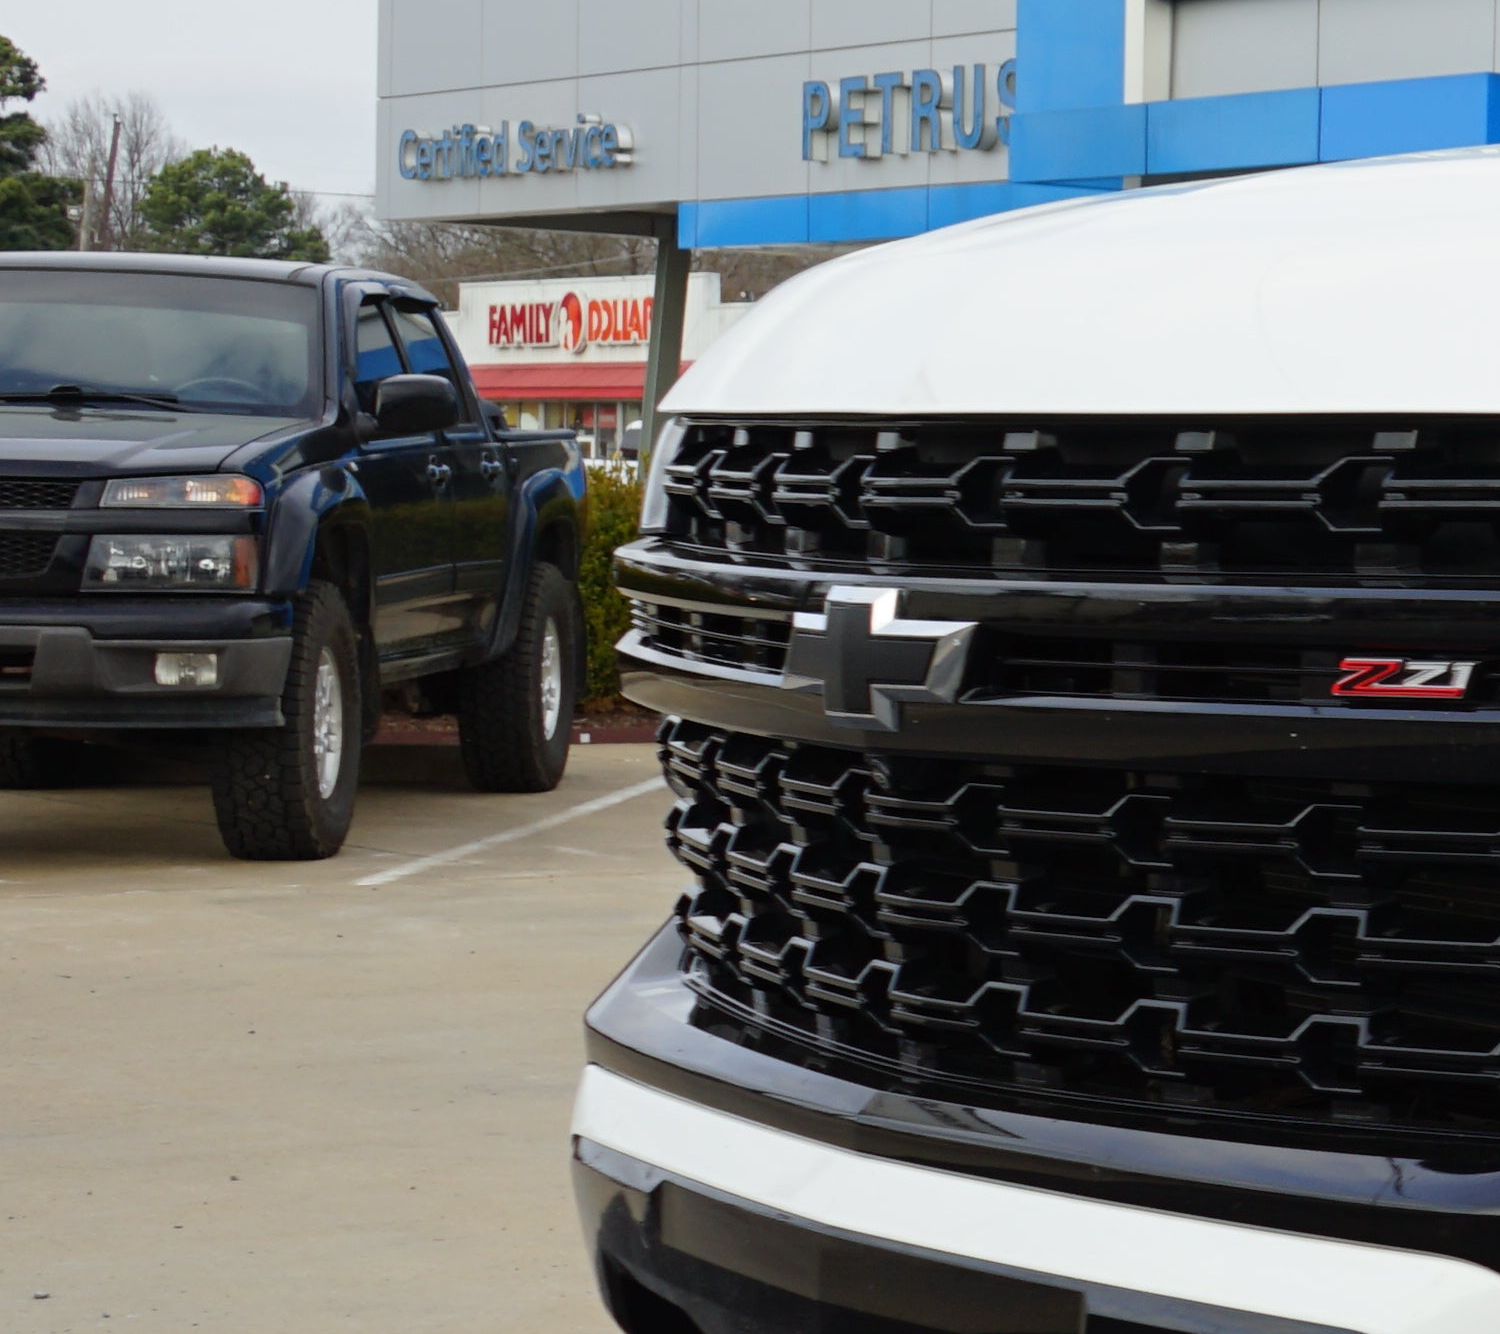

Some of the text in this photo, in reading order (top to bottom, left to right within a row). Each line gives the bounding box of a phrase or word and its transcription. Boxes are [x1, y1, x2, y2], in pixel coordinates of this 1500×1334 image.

[399, 113, 634, 181] Certified Service
[488, 301, 556, 345] FAMILY
[1331, 657, 1482, 699] Z71
